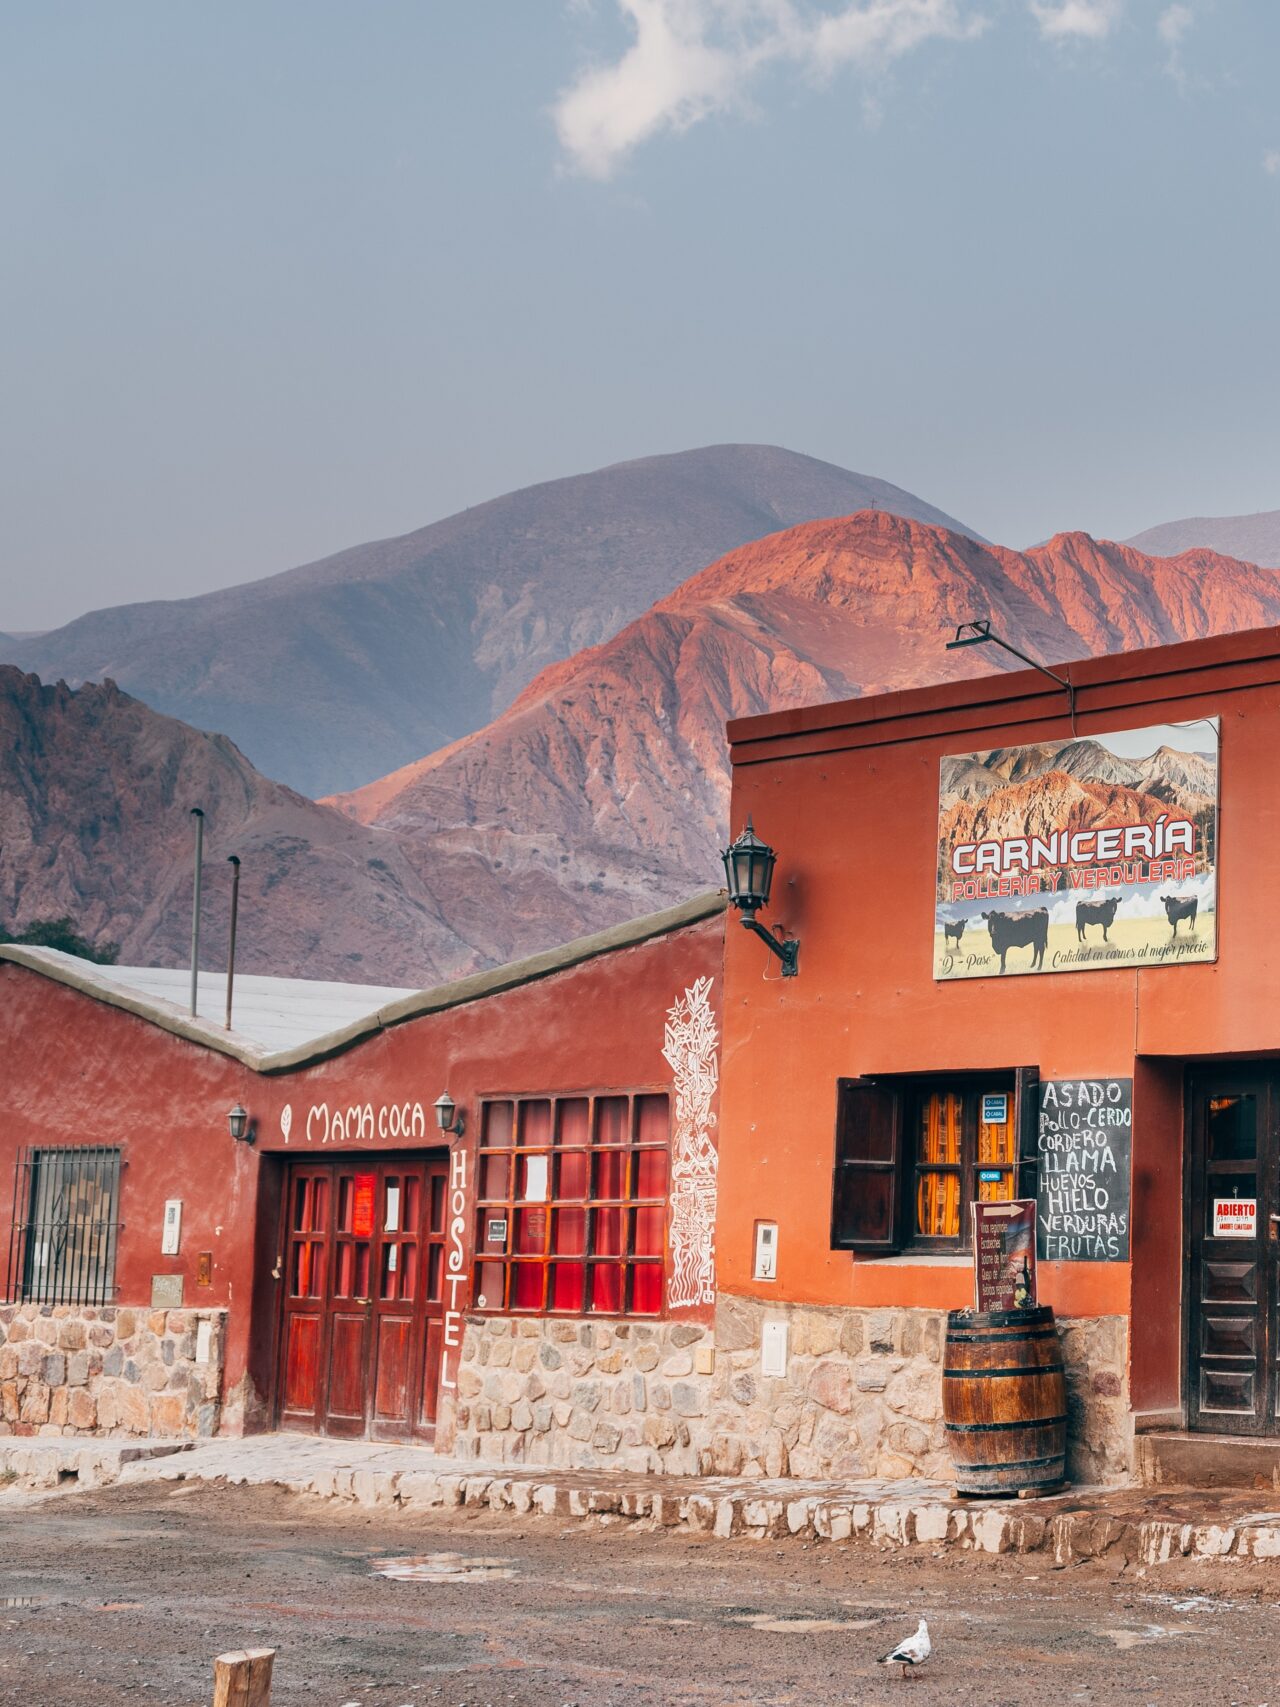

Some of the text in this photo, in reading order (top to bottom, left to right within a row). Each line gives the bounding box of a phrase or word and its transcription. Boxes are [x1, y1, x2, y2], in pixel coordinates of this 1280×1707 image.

[952, 814, 1193, 875] CARNICERÍA
[952, 859, 1195, 902] POLLERIA Y VERDULERIA
[1052, 940, 1209, 968] Calidad en carnes al mejor precio
[1042, 1081, 1122, 1109] ASADO
[1038, 1129, 1107, 1152] CORDERO
[1044, 1146, 1117, 1173] LLAMA
[1040, 1174, 1096, 1193] HUEVOS
[1048, 1188, 1109, 1214] HIELO
[1217, 1203, 1255, 1216] ABIERTO
[1039, 1213, 1127, 1235] VERDURAS
[1046, 1236, 1120, 1260] FRUTAS
[441, 1150, 467, 1388] HOSTEL
